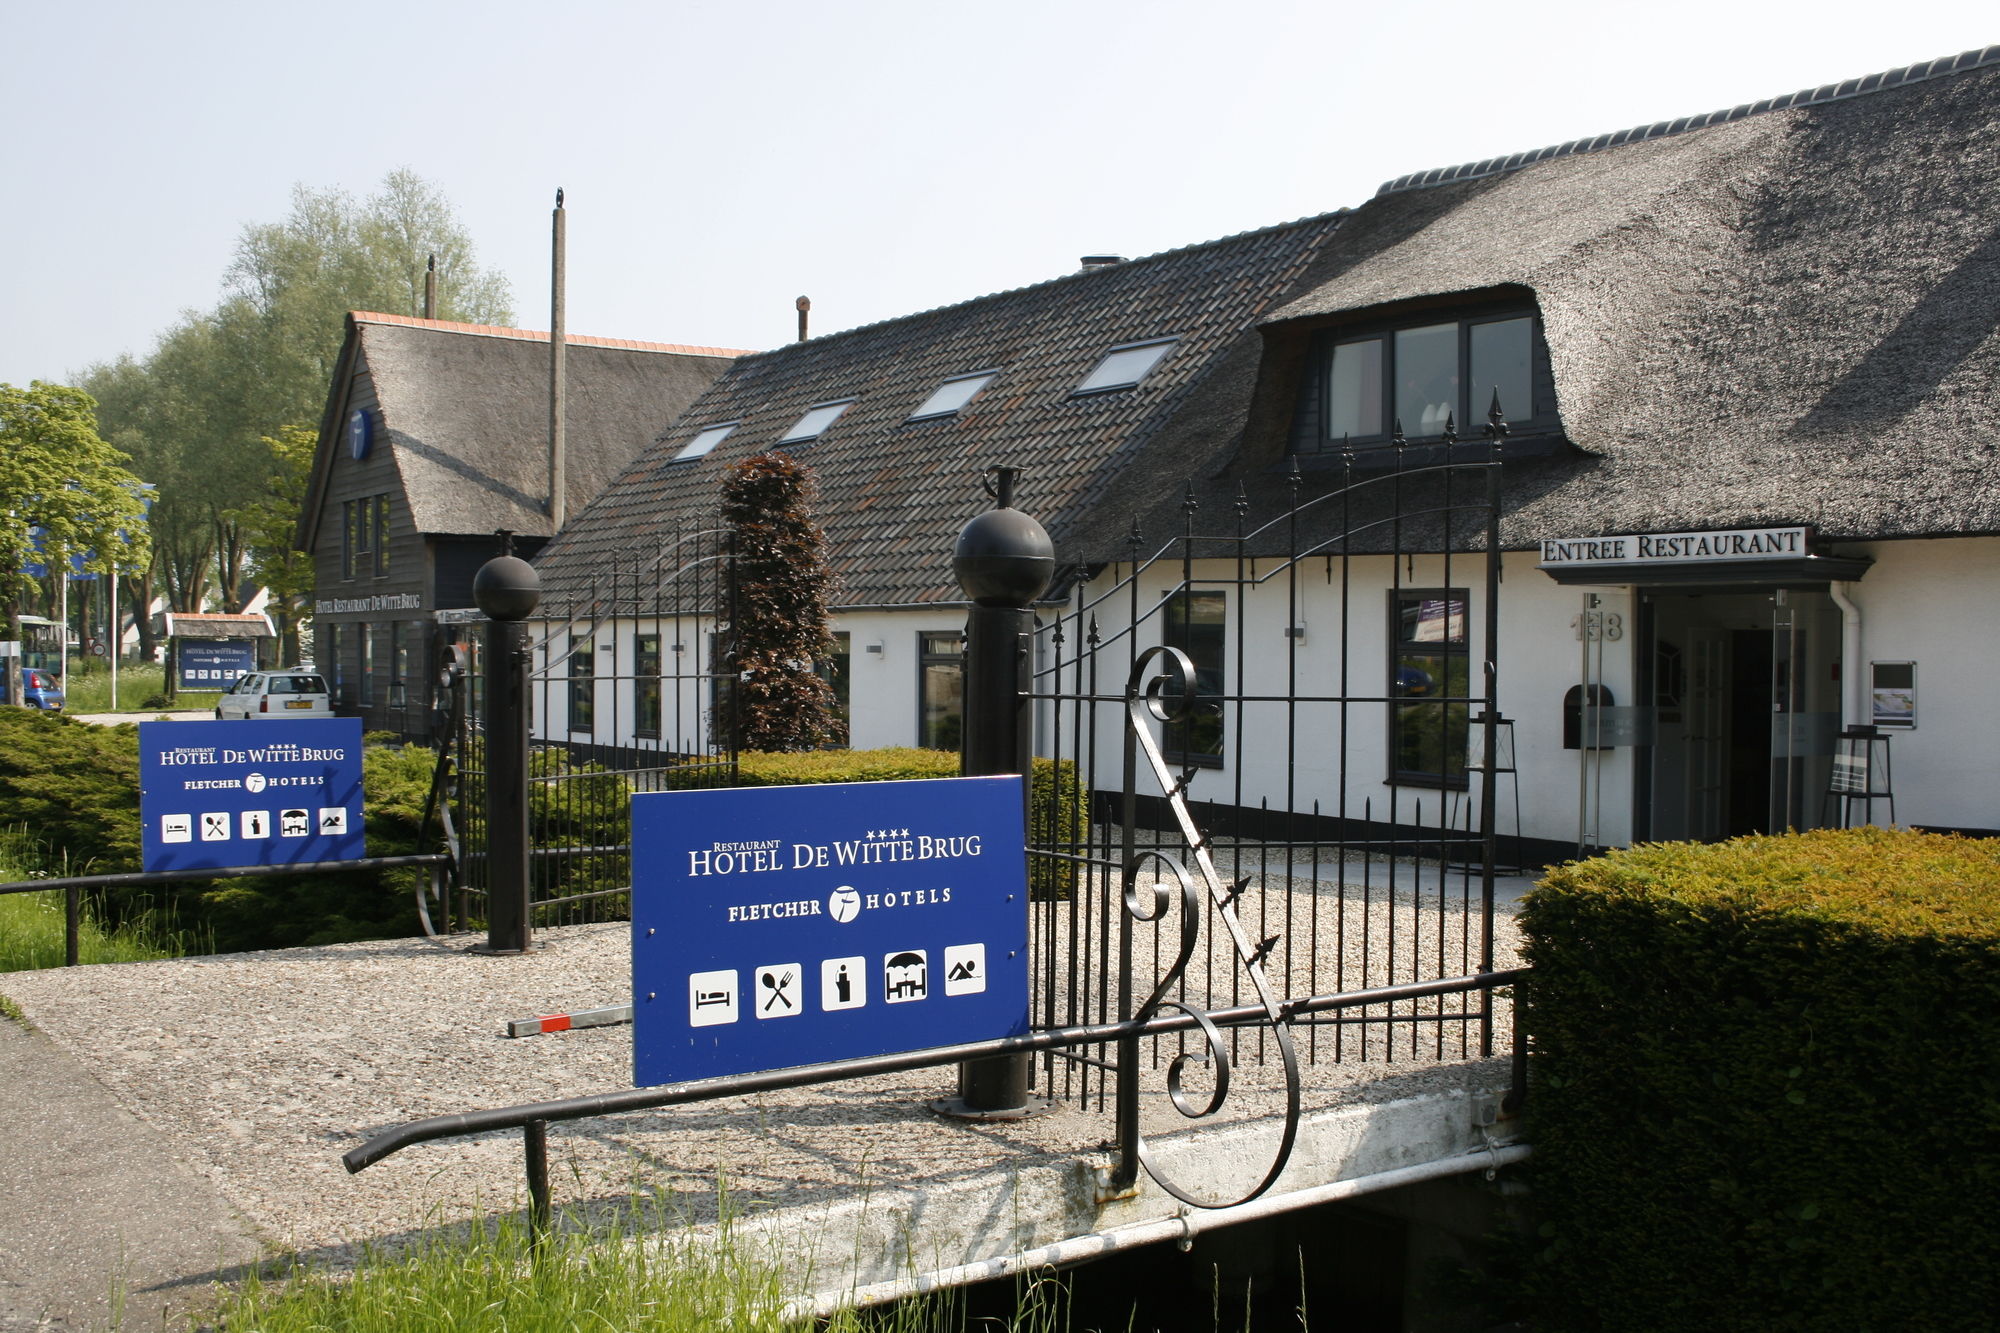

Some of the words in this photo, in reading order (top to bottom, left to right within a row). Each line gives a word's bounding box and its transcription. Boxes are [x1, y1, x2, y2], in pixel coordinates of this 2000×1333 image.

[1542, 540, 1625, 562] ENTREE
[1637, 532, 1801, 558] RESTAURANT
[316, 600, 333, 613] HOTEL
[334, 599, 370, 613] RESTAURANT
[371, 596, 380, 611] DE
[380, 595, 401, 610] WITTE
[401, 593, 420, 609] BRUG
[160, 751, 218, 766] HOTEL
[223, 749, 246, 764] DE
[248, 749, 300, 763] WITTE
[302, 748, 345, 761] BRUG
[184, 779, 242, 790] FLETCHER
[269, 776, 324, 786] HOTELS
[713, 839, 782, 852] RESTAURANT
[688, 849, 784, 877] HOTEL
[792, 843, 830, 869] DE
[833, 840, 914, 866] WITTE
[917, 835, 982, 860] BRUG
[728, 900, 822, 922] FLETCHER
[866, 887, 951, 909] HOTELS
